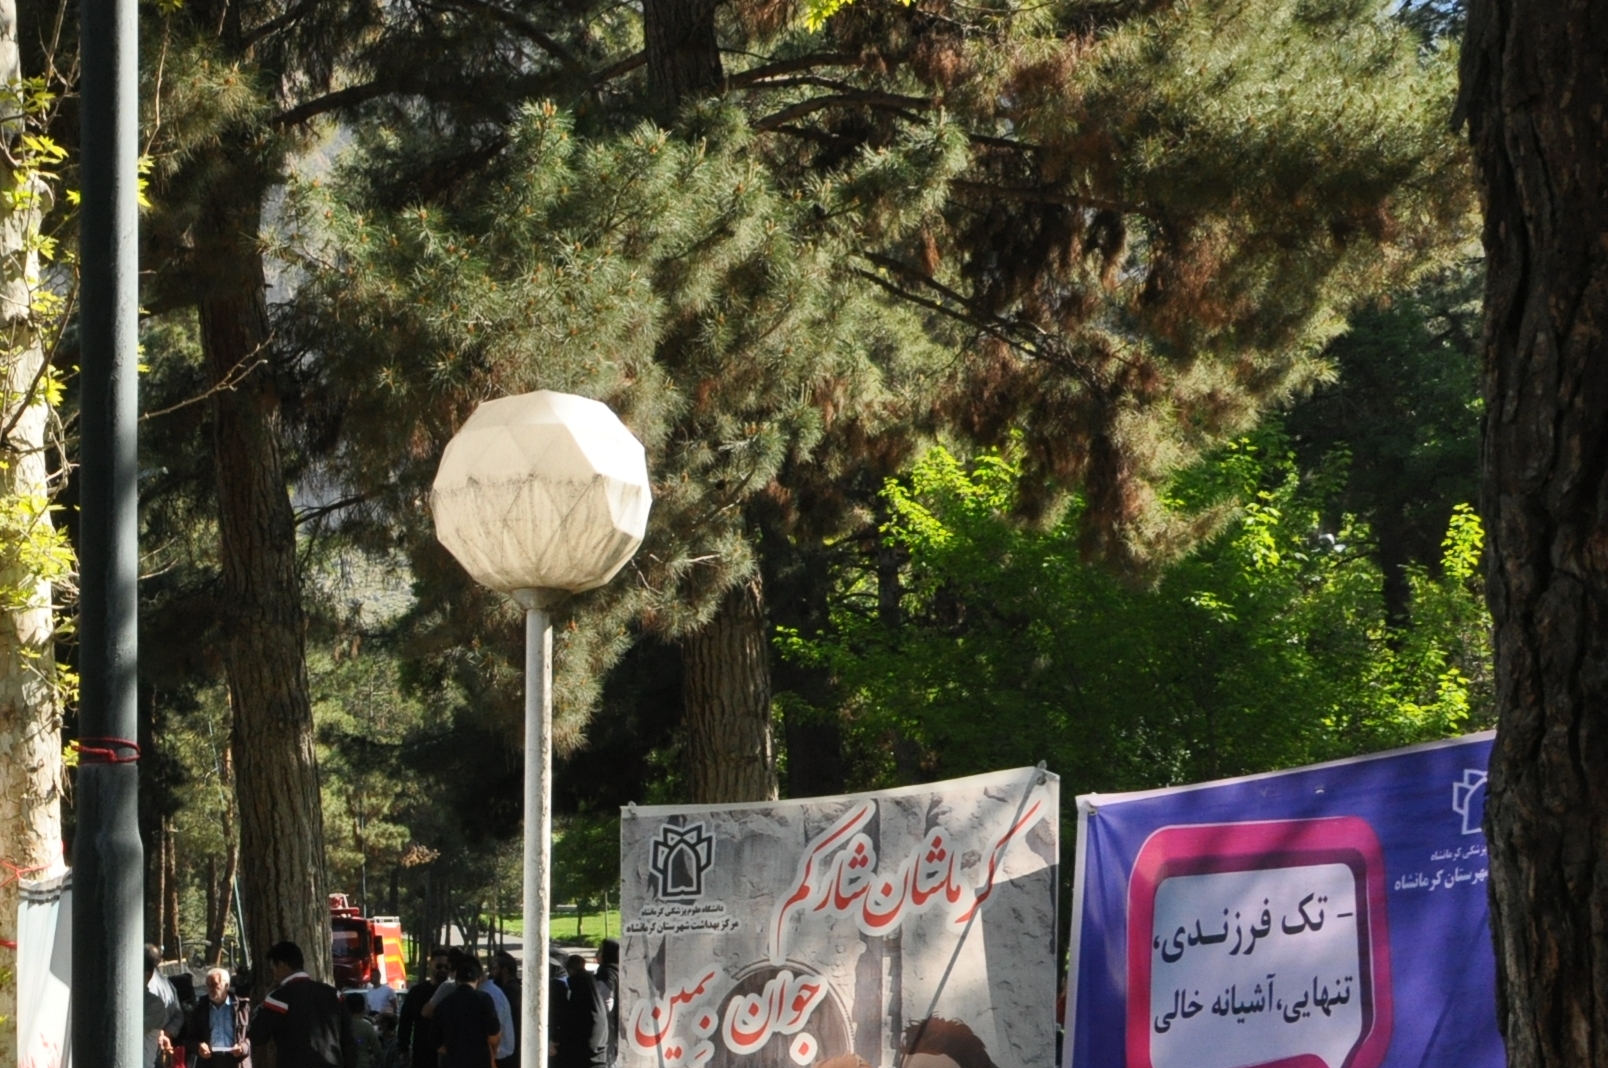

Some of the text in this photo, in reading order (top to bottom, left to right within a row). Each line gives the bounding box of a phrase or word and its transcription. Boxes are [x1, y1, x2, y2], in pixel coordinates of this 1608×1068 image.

[1430, 847, 1462, 861] کرمانشاه
[1394, 869, 1444, 891] کرمانشاه
[641, 904, 724, 917] دانشگاه علوم پزشکی کرمانشاه
[1281, 893, 1328, 935] تک
[626, 919, 739, 935] مرکز بهداشت شهرستان کرمانشاه
[730, 979, 821, 1056] جوان
[1154, 988, 1204, 1033] خالی
